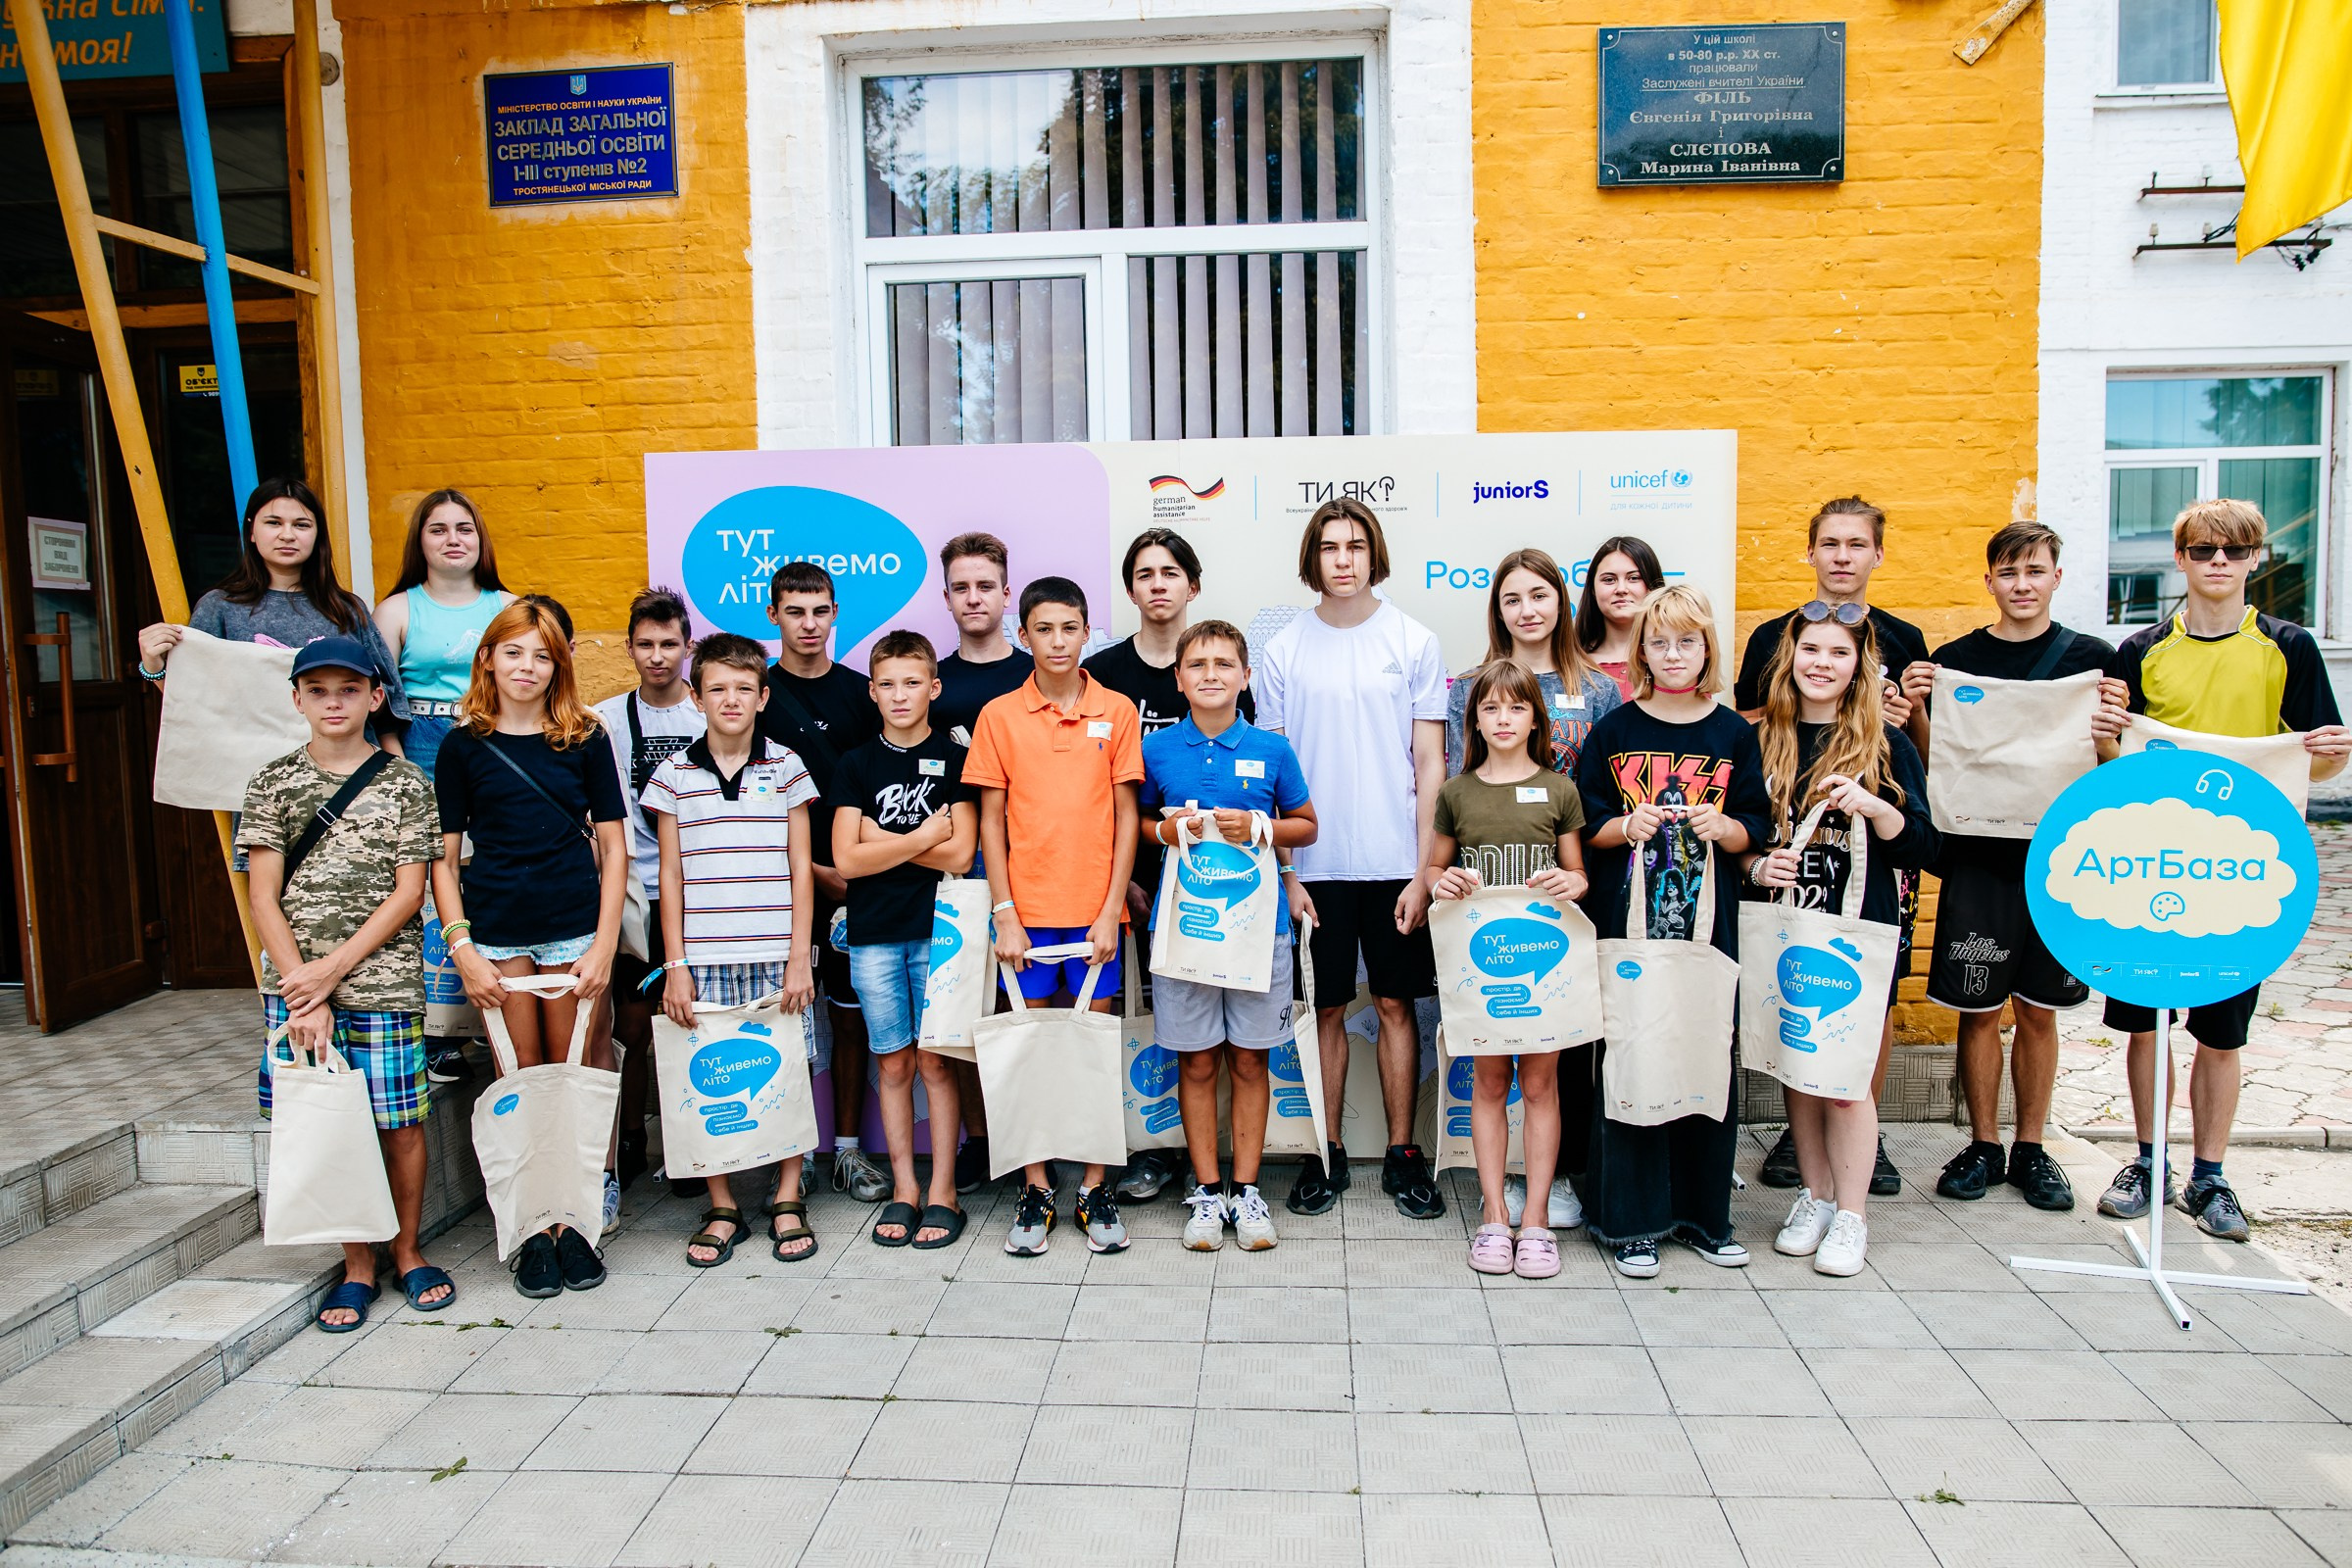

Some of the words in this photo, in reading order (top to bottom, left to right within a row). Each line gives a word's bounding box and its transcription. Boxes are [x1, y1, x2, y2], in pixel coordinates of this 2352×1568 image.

[1693, 34, 1700, 44] У
[1703, 34, 1720, 45] цій
[1724, 34, 1756, 44] школі
[54, 30, 132, 66] моя!
[1679, 50, 1712, 61] 50-80
[1716, 52, 1738, 63] р.р.
[1764, 51, 1780, 59] ст.
[1689, 63, 1758, 76] працювали
[1642, 77, 1705, 90] Заслужені
[1709, 77, 1753, 88] вчителі
[1757, 75, 1804, 87] України
[498, 102, 558, 114] МІНІСТЕРСТВО
[560, 101, 591, 110] ОСВІТИ
[598, 99, 625, 107] НАУКИ
[627, 95, 662, 107] УКРАЇНИ
[1694, 91, 1751, 105] ФІЛЬ
[494, 117, 564, 138] ЗАКЛАД
[569, 106, 666, 132] ЗАГАЛЬНОЇ
[1630, 110, 1702, 124] Євгенія
[1710, 108, 1813, 124] Григорівна
[497, 135, 596, 161] СЕРЕДНЬОЇ
[1670, 143, 1772, 157] СЛЄПОВА
[543, 162, 613, 182] ступенів
[617, 157, 647, 175] №2
[1641, 161, 1714, 175] Марина
[1721, 159, 1800, 173] Іванівна
[514, 183, 586, 196] ТРОСТЯНЕЦЬКОЇ
[589, 180, 626, 191] МІСЬКОЇ
[627, 179, 652, 189] РАДИ
[1611, 470, 1668, 488] unicef
[1298, 482, 1333, 503] ТИ
[1343, 476, 1395, 502] ЯК?
[1473, 480, 1549, 503] juniorS
[1153, 496, 1186, 505] german
[1628, 502, 1658, 510] кожної
[1662, 502, 1692, 510] дитини
[716, 529, 775, 557] тут
[718, 575, 772, 604] літ
[1608, 751, 1733, 814] KISS
[876, 777, 935, 825] BACK
[896, 816, 907, 824] TO
[1191, 854, 1211, 866] тут
[2073, 848, 2265, 884] АртБаза
[931, 936, 953, 946] емо
[1483, 935, 1506, 947] тут
[1498, 940, 1559, 954] живемо
[1966, 932, 1995, 949] Los
[429, 944, 449, 954] літ
[1949, 942, 2010, 963] Angeles
[1485, 953, 1514, 965] літо
[1786, 958, 1802, 971] тут
[1783, 978, 1804, 993] літо
[1792, 972, 1852, 990] живемо
[1964, 964, 1989, 996] 13
[700, 1056, 722, 1069] тут
[714, 1056, 771, 1076] живемо
[1152, 1059, 1179, 1075] живе
[703, 1074, 730, 1086] літо
[1143, 1075, 1164, 1087] літо
